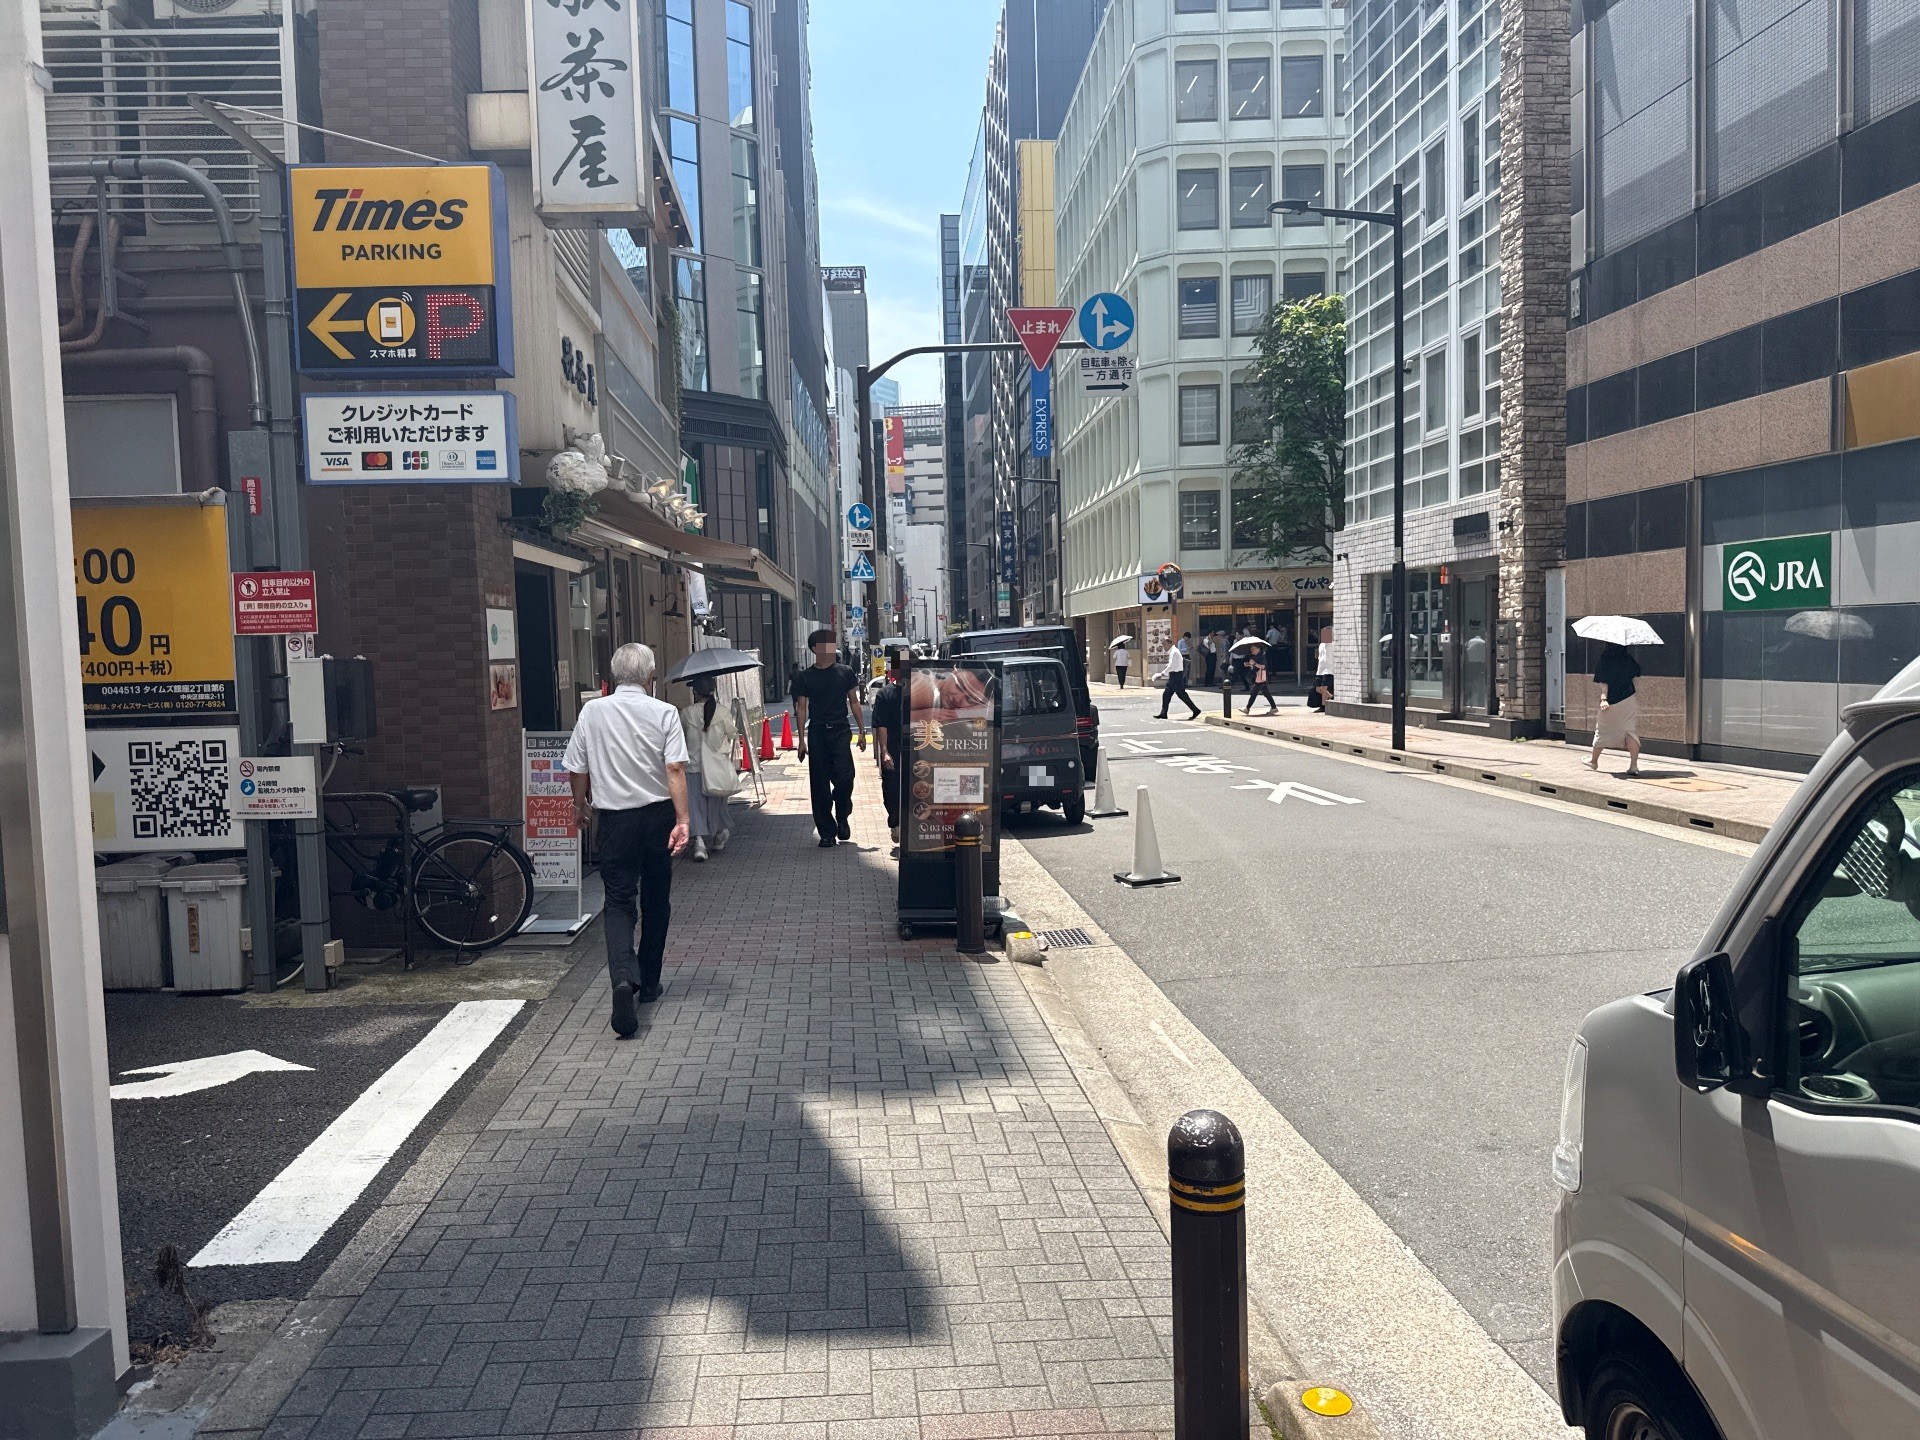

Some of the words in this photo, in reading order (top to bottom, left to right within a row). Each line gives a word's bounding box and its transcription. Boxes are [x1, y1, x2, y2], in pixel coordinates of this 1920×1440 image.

[313, 188, 469, 232] Times
[341, 243, 442, 261] PARKING
[426, 293, 485, 359] P
[1020, 320, 1060, 335] 止まれ
[369, 348, 417, 359] スマホ精算
[1081, 356, 1134, 368] 自転車を除く
[1083, 369, 1133, 381] 一方通行
[341, 403, 474, 422] クレジットカード
[1035, 398, 1048, 451] EXPRESS
[328, 425, 489, 445] ご利用いただけます
[325, 457, 349, 467] VISA
[403, 456, 429, 464] JCB
[1770, 557, 1825, 592] JRA
[1231, 579, 1273, 592] TENYA
[1291, 576, 1329, 590] てんや
[261, 587, 291, 597] 立入禁止
[101, 686, 141, 695] 0044513
[913, 719, 945, 751] 美
[945, 739, 989, 751] FRESH
[529, 818, 574, 827] 専門サロン
[541, 868, 557, 879] Vie
[558, 868, 576, 879] Aid
